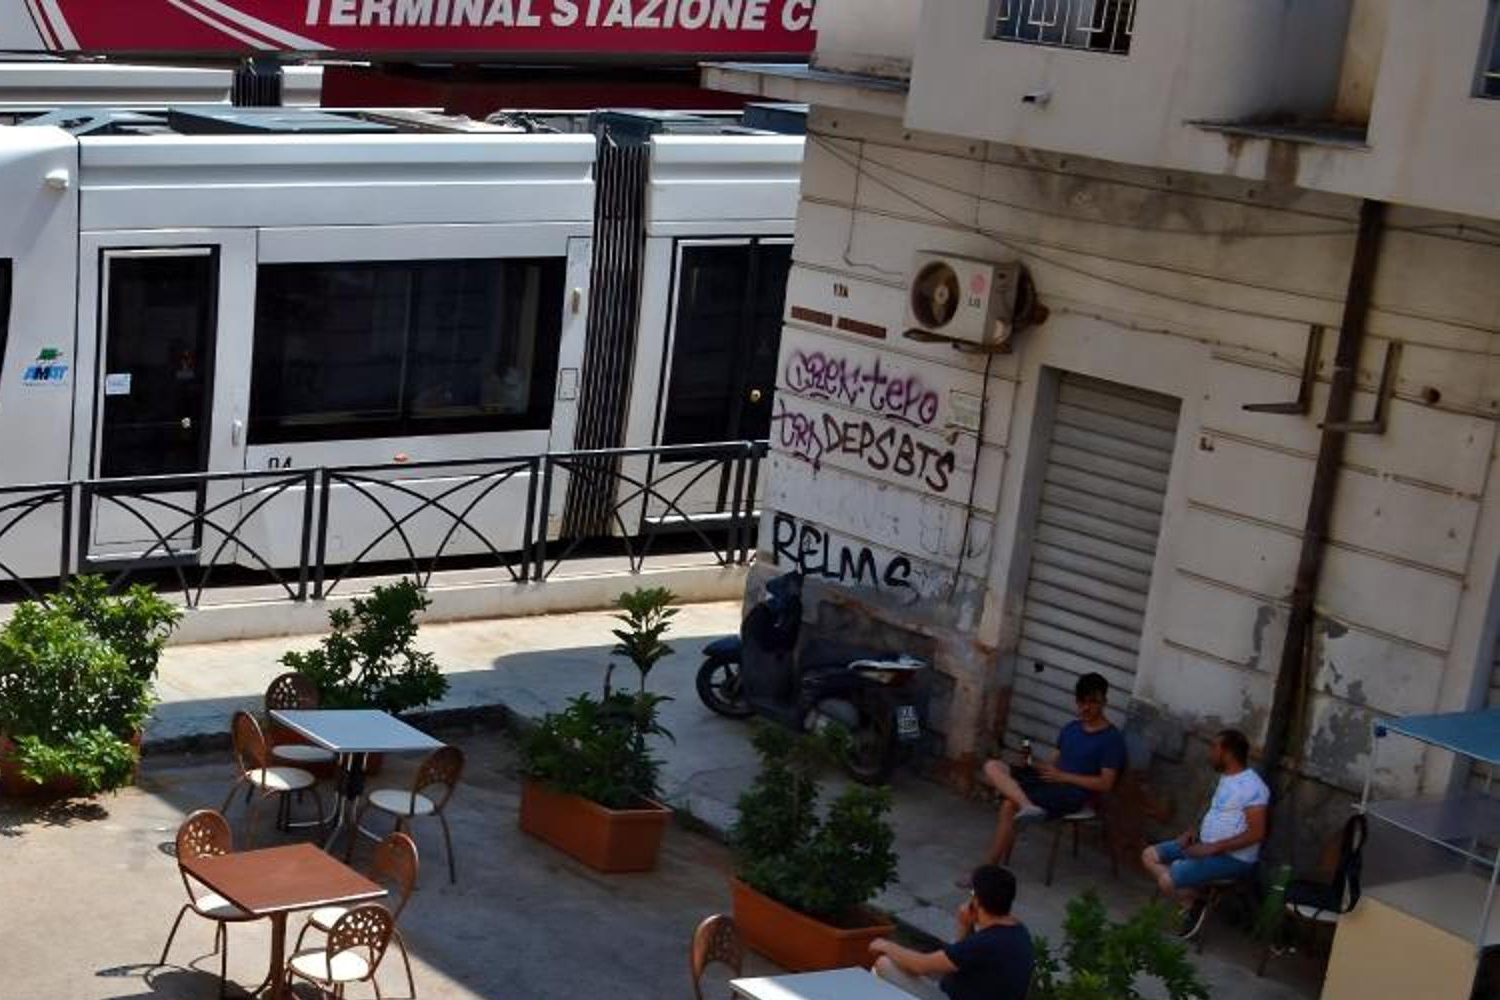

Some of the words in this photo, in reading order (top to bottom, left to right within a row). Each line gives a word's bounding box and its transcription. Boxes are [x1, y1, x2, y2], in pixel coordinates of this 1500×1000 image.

[304, 0, 542, 27] TERMINAL
[550, 0, 768, 31] STAZIONE
[780, 0, 817, 31] C
